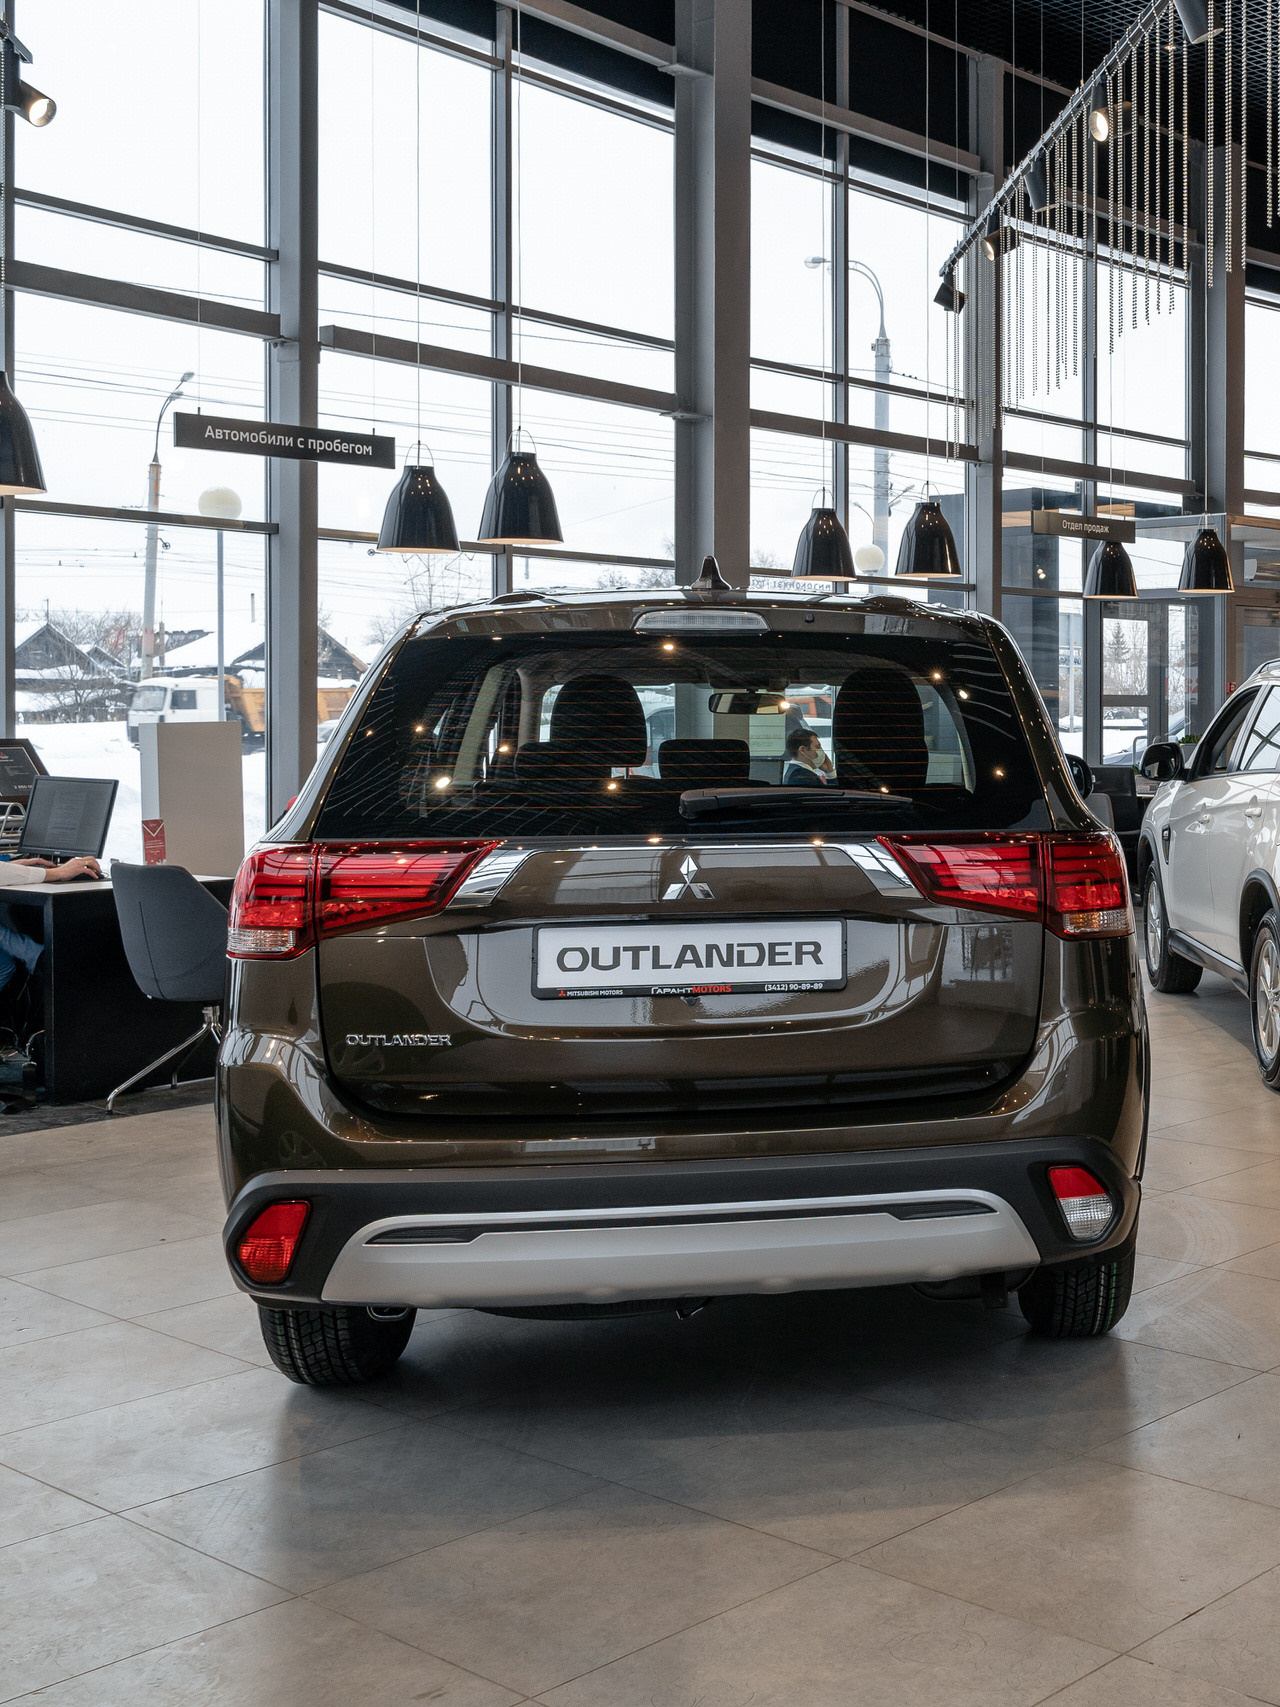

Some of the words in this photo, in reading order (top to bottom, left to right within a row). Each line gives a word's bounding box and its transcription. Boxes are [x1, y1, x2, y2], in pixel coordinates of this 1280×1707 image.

[205, 425, 294, 447] Автомобили
[297, 437, 305, 449] с
[308, 438, 373, 456] пробегом
[1061, 519, 1082, 531] Отдел
[1083, 523, 1110, 534] продаж
[556, 941, 824, 972] OUTLANDER
[566, 989, 599, 997] MITSUBISHI
[764, 983, 788, 992] (3412)
[789, 982, 823, 990] 90-89-89
[345, 1033, 453, 1046] OUTLANDER
